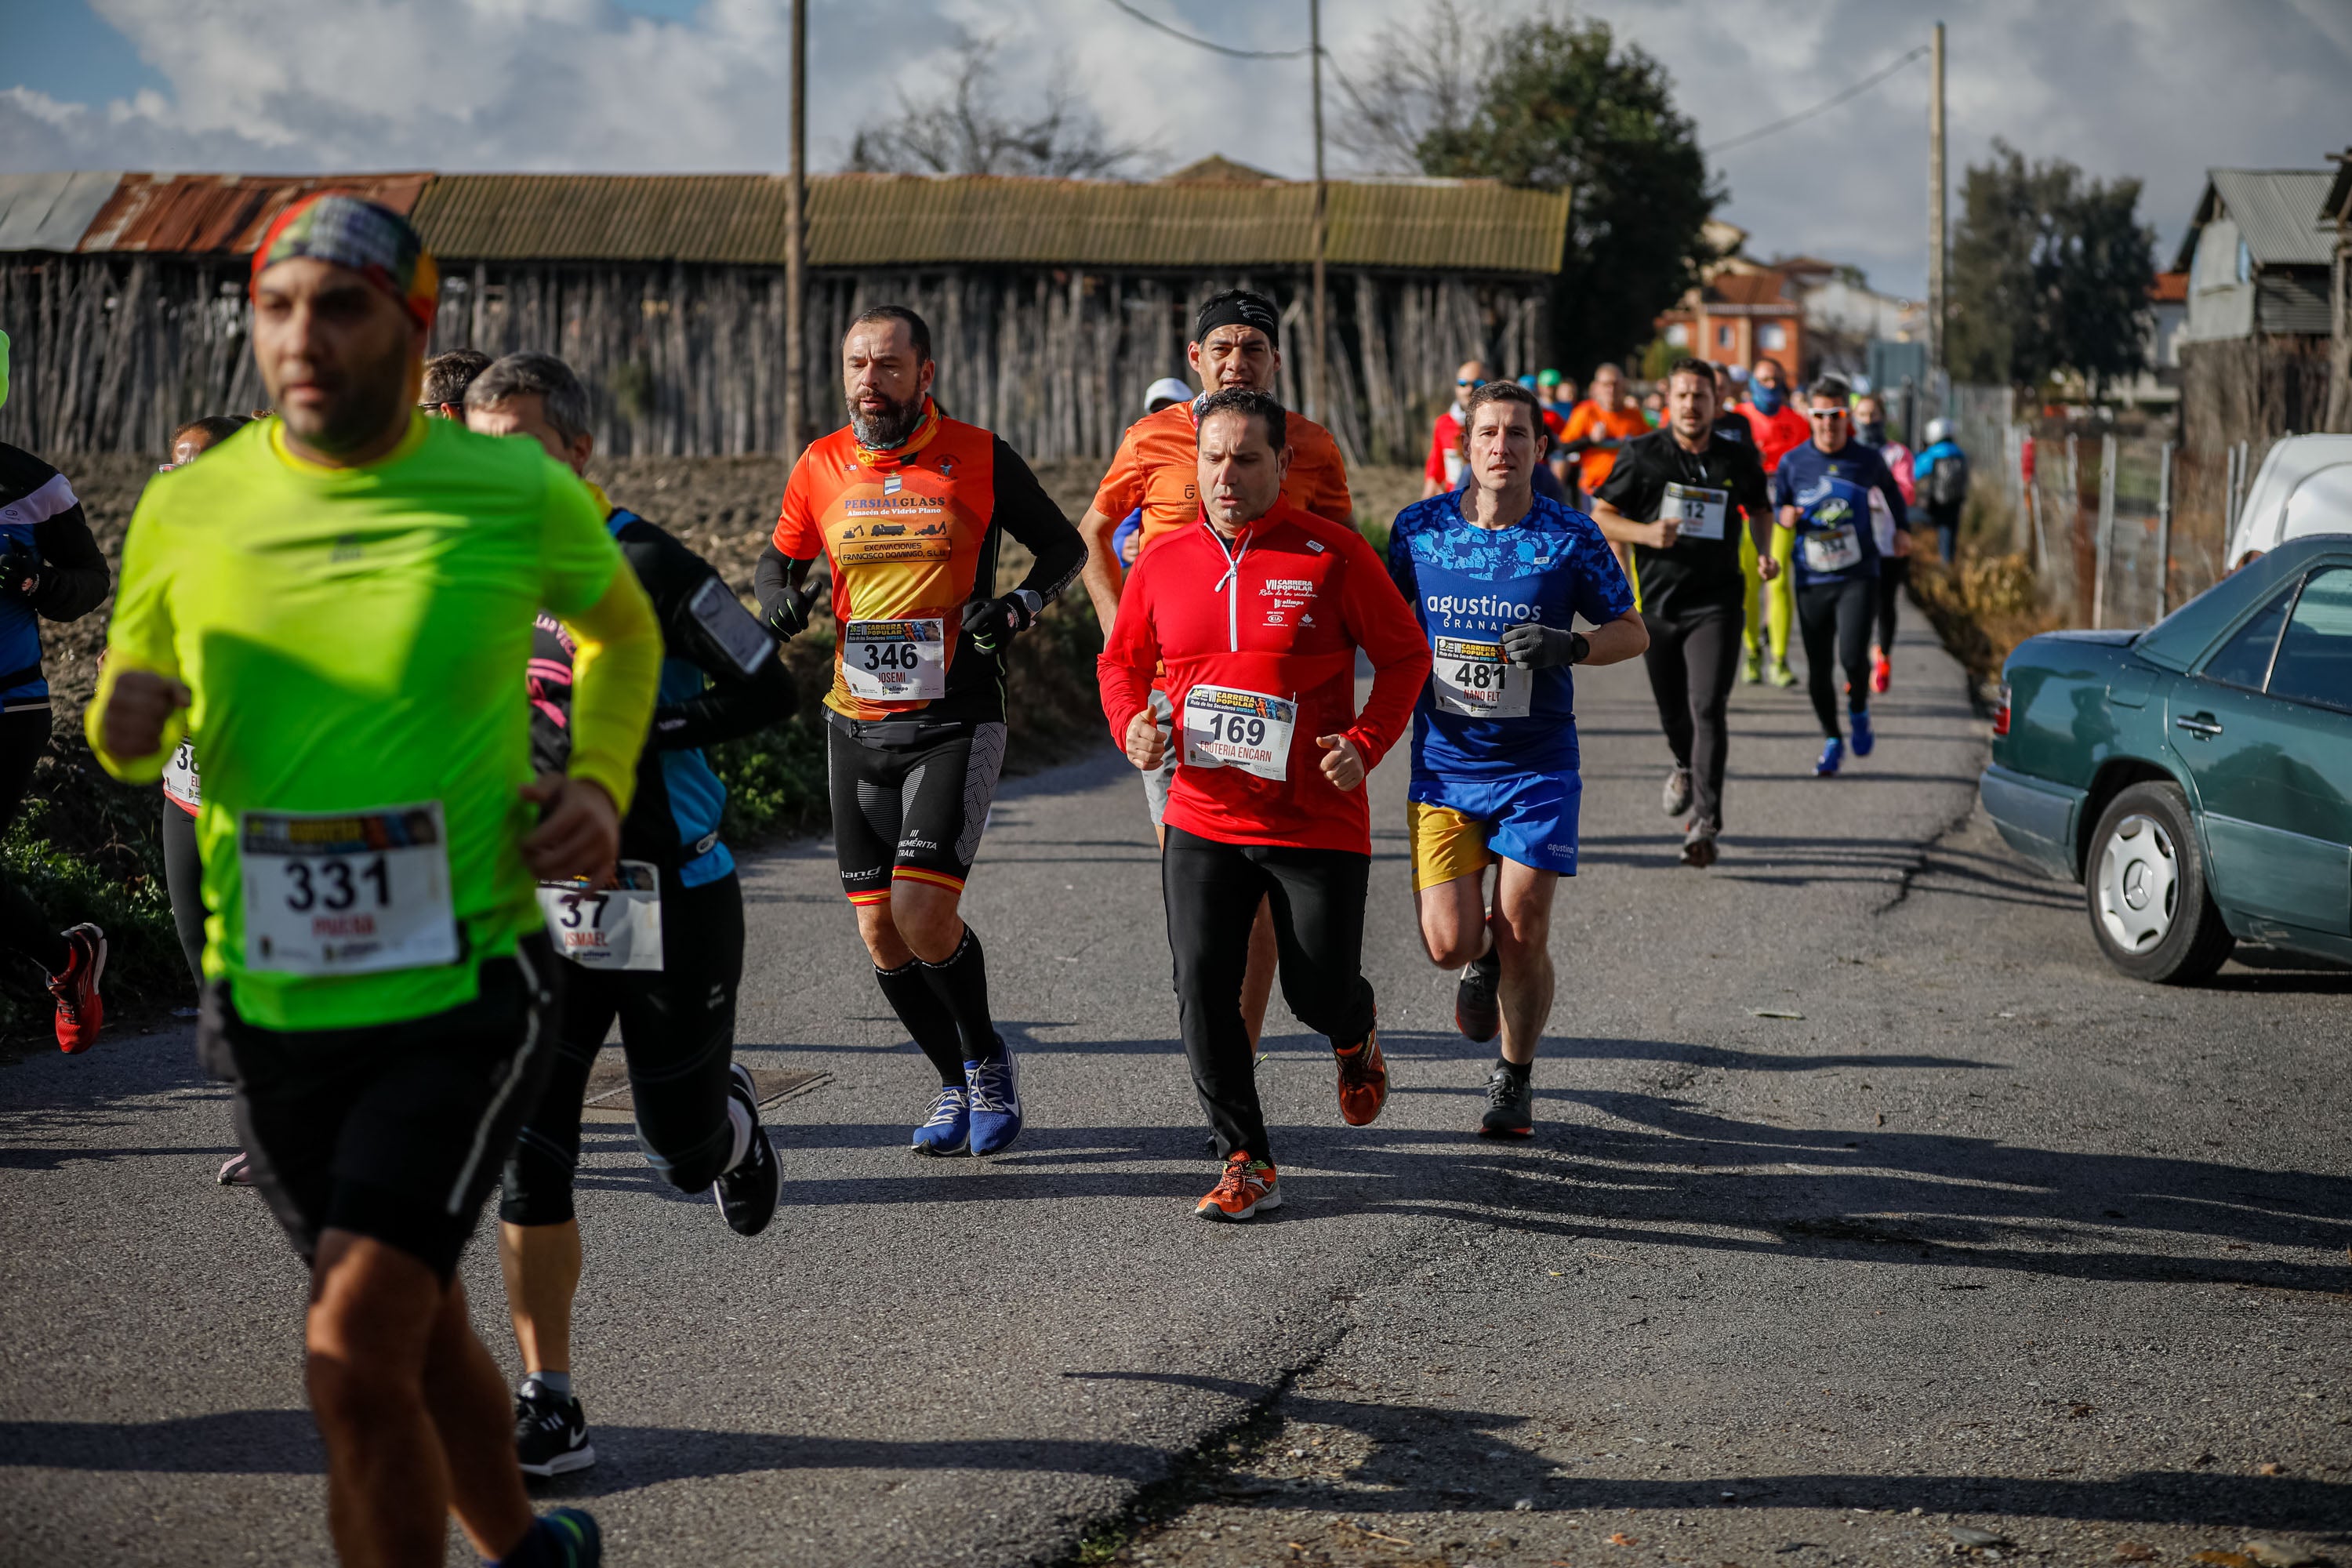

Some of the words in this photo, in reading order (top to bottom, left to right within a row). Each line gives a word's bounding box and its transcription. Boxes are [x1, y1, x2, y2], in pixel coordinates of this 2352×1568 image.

[844, 497, 946, 509] PERSIALGLASS
[1686, 502, 1705, 519] 12
[864, 543, 922, 551] EXCAVACIONES
[843, 552, 884, 561] FRANCISCO
[885, 550, 925, 560] DOMINGO,
[1265, 579, 1277, 590] VII
[1427, 594, 1542, 622] agustinos
[1461, 643, 1496, 652] CARRERA
[864, 644, 918, 670] 346
[878, 672, 906, 683] JOSEMI
[1455, 662, 1505, 689] 481
[1192, 688, 1202, 698] 26
[1216, 691, 1254, 703] CARRERA
[1463, 689, 1485, 702] NANO
[1487, 691, 1501, 702] FLT
[1214, 702, 1236, 711] Secaderos
[1216, 698, 1254, 709] POPULAR
[1210, 713, 1265, 746] 169
[1200, 740, 1236, 757] FRUTERIA
[1238, 746, 1272, 763] ENCARN
[1548, 844, 1574, 854] agustinos
[284, 853, 390, 912] 331
[560, 894, 609, 928] 37
[564, 931, 608, 947] ISMAEL
